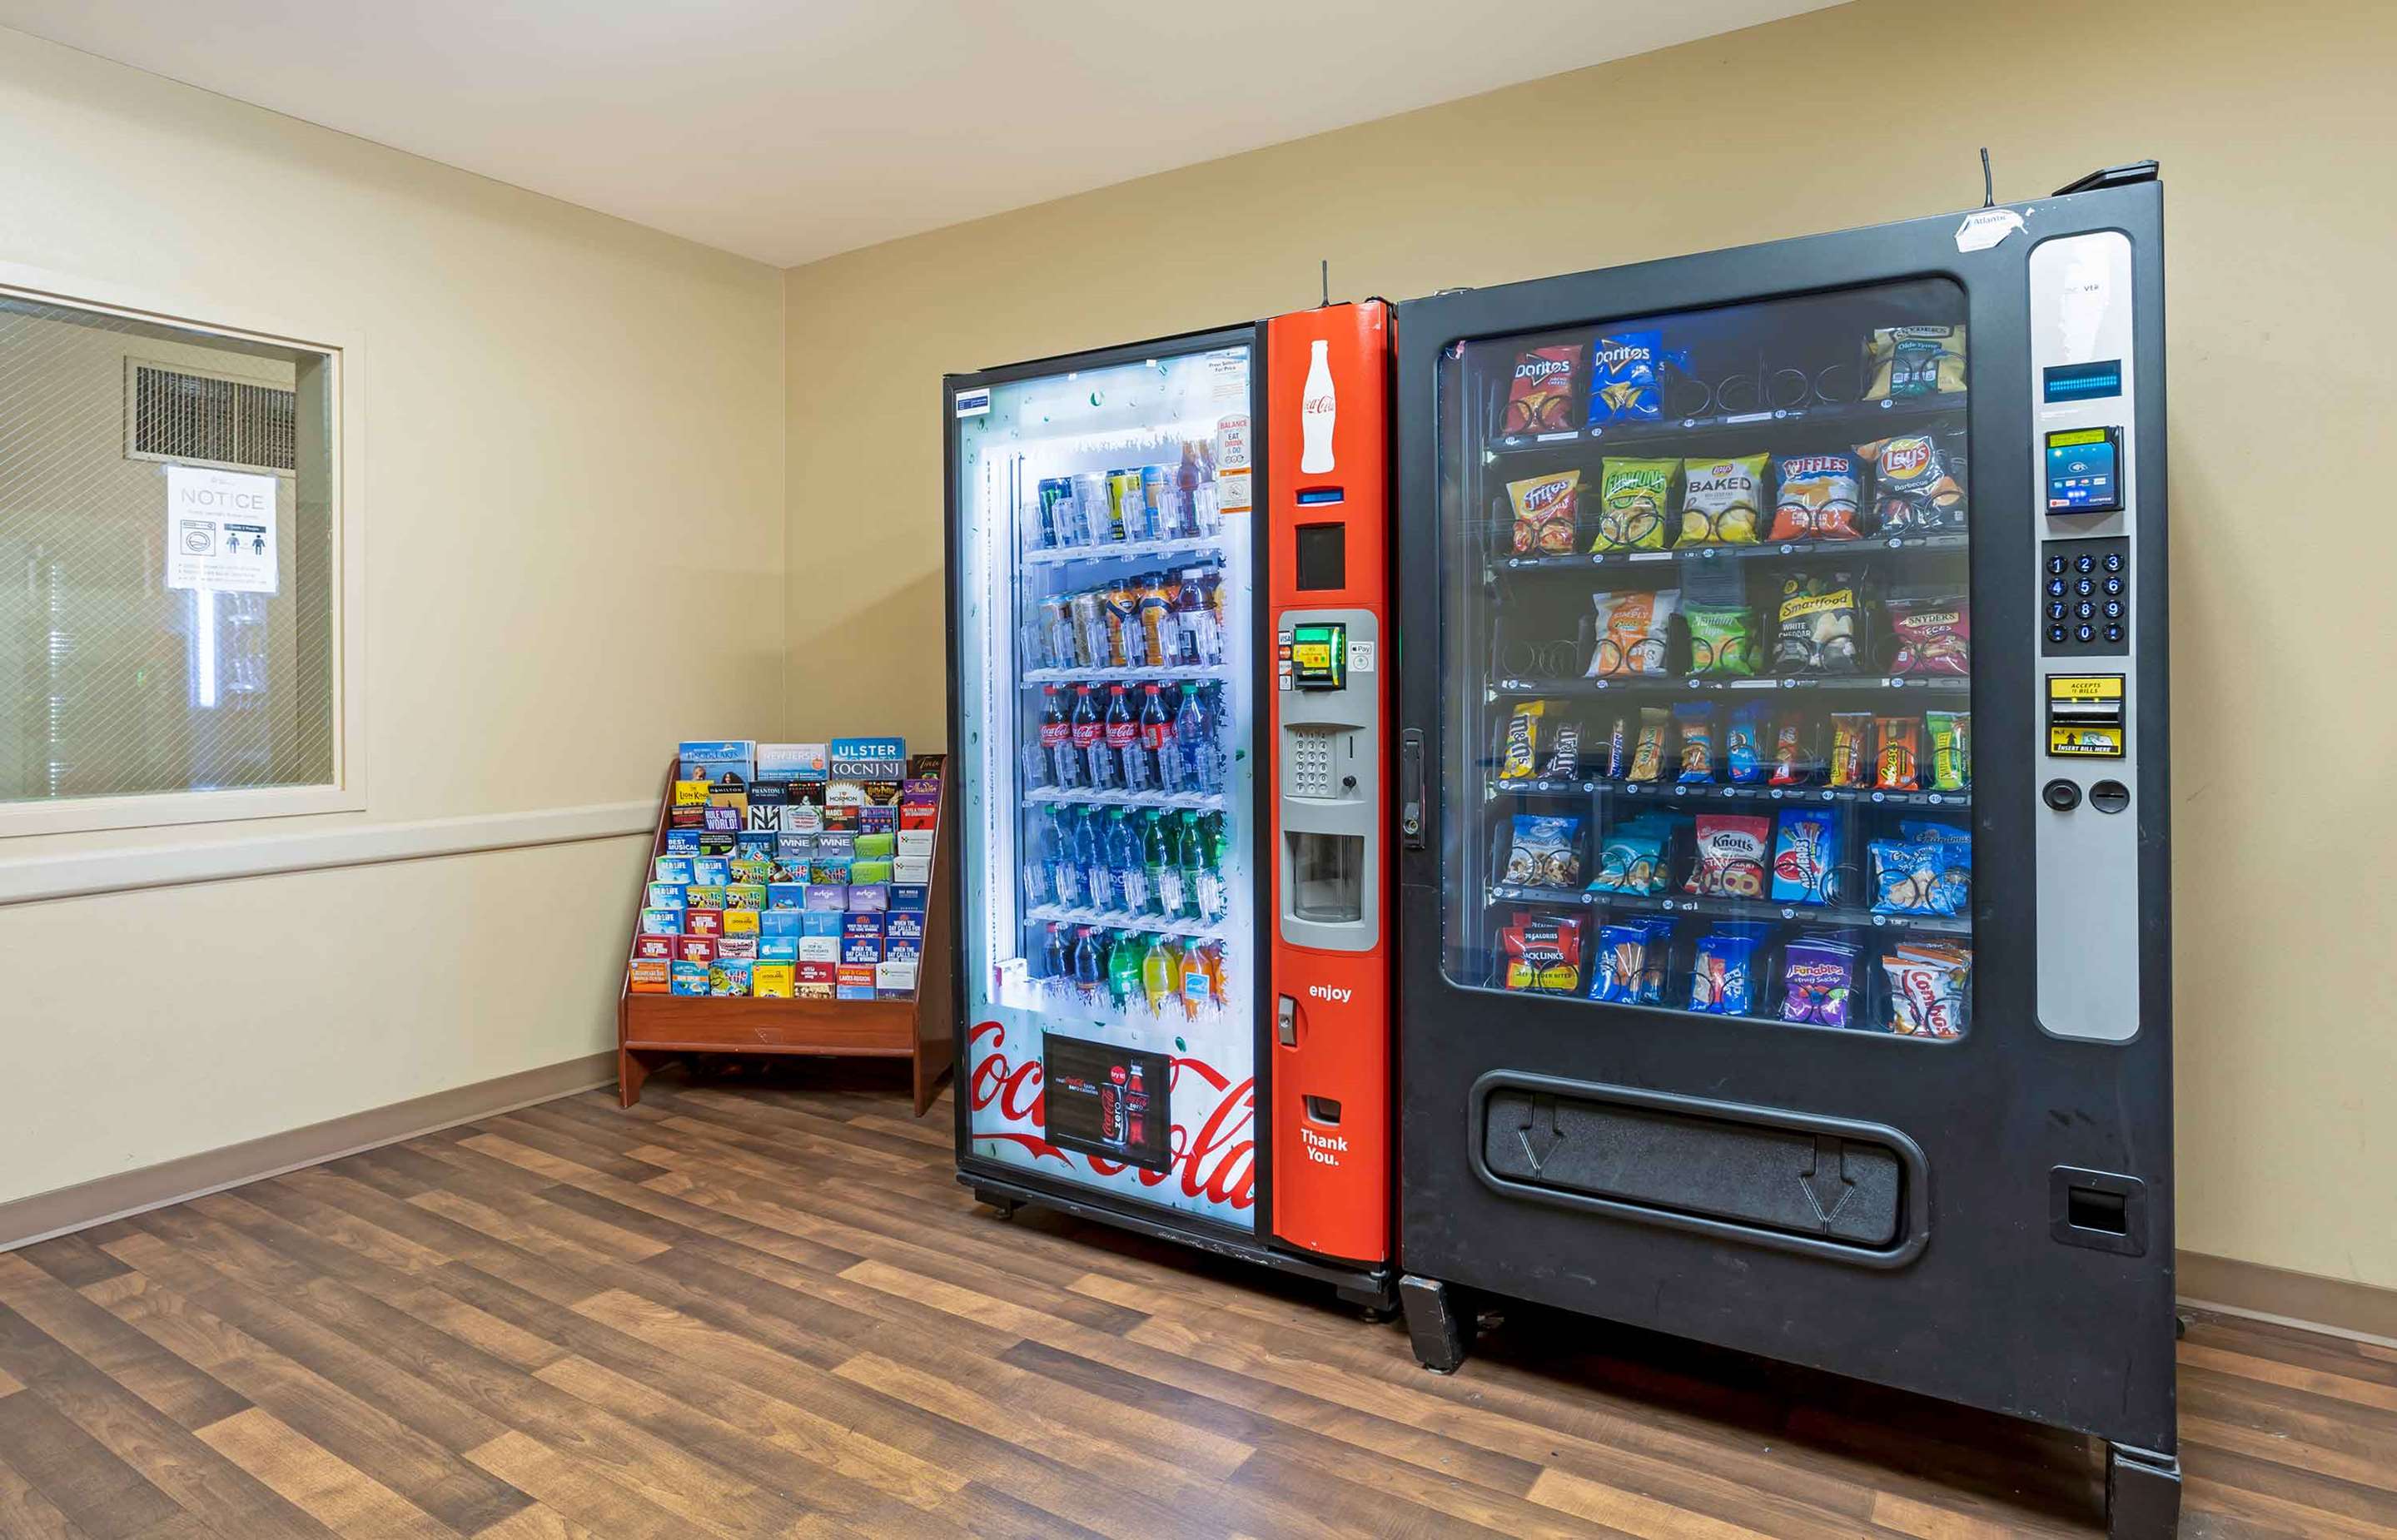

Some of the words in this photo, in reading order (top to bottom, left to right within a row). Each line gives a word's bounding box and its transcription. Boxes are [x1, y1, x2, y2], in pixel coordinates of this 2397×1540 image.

[1595, 347, 1650, 366] Doritos
[1514, 360, 1570, 379] Doritos
[1220, 420, 1247, 430] BALANCE
[1688, 477, 1752, 493] BAKED
[1894, 479, 1929, 492] Barbecue
[181, 488, 266, 510] NOTICE
[2053, 559, 2060, 570] 1
[2081, 558, 2090, 569] 2
[2109, 556, 2118, 568] 3
[2052, 582, 2061, 593] 4
[2081, 581, 2090, 592] 5
[2109, 580, 2118, 591] 6
[1783, 594, 1848, 617] Smartfood
[2053, 604, 2061, 616] 7
[2081, 604, 2090, 614] 8
[2109, 603, 2118, 614] 9
[1783, 622, 1806, 631] WHITE
[2081, 627, 2089, 638] 0
[1358, 645, 1370, 653] Pay
[839, 746, 896, 756] ULSTER
[883, 763, 899, 777] NJ
[705, 811, 720, 819] RULE
[720, 810, 737, 819] YOUR
[707, 817, 738, 830] WORLD!
[779, 839, 810, 847] WINE
[820, 838, 851, 847] WINE
[1712, 833, 1753, 852] Knott's
[1793, 964, 1844, 976] Funables
[1309, 984, 1352, 1003] enjoy
[1300, 1128, 1348, 1152] Thank
[1306, 1145, 1340, 1166] You.
